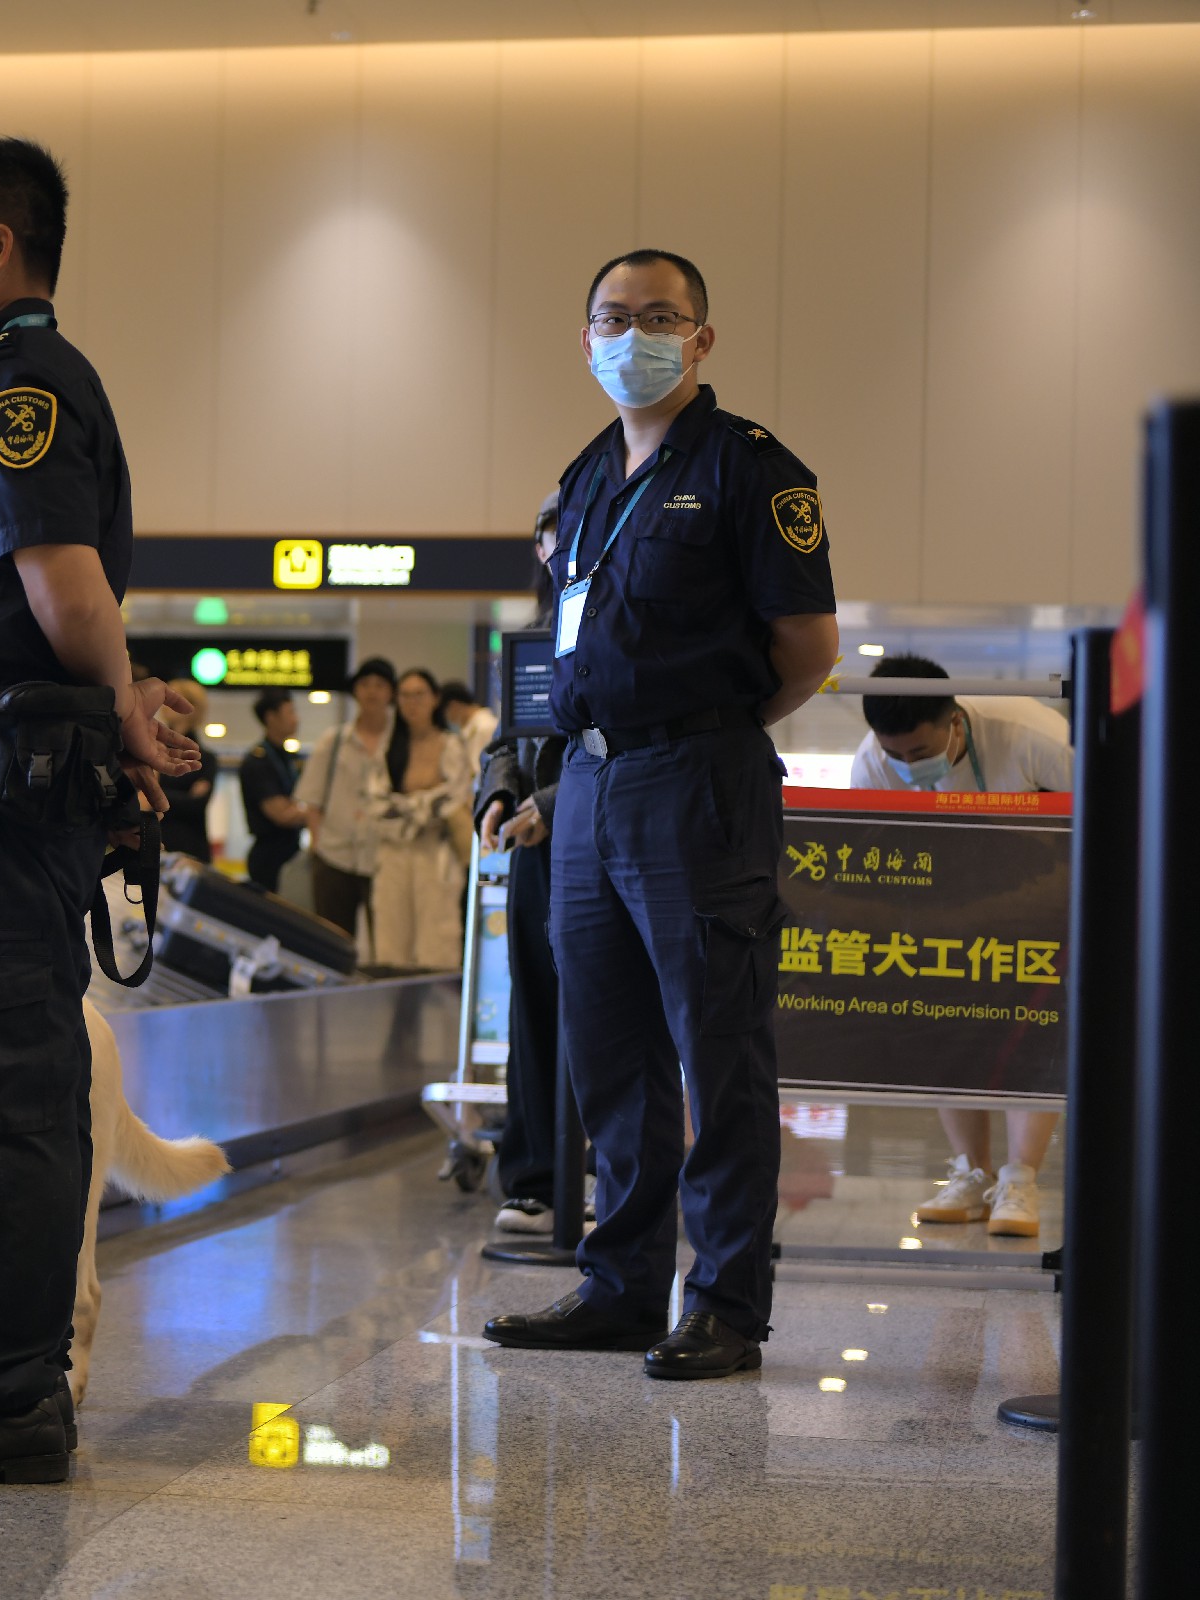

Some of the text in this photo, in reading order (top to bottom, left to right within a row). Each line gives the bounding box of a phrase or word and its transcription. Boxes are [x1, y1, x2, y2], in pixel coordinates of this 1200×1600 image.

[11, 395, 50, 410] CUSTOMS
[673, 494, 696, 502] CHINA
[834, 872, 933, 886] CHINA CUSTOMS
[778, 926, 1061, 984] 监管犬工作区
[778, 993, 1059, 1026] Working Area of Supervision Dogs
